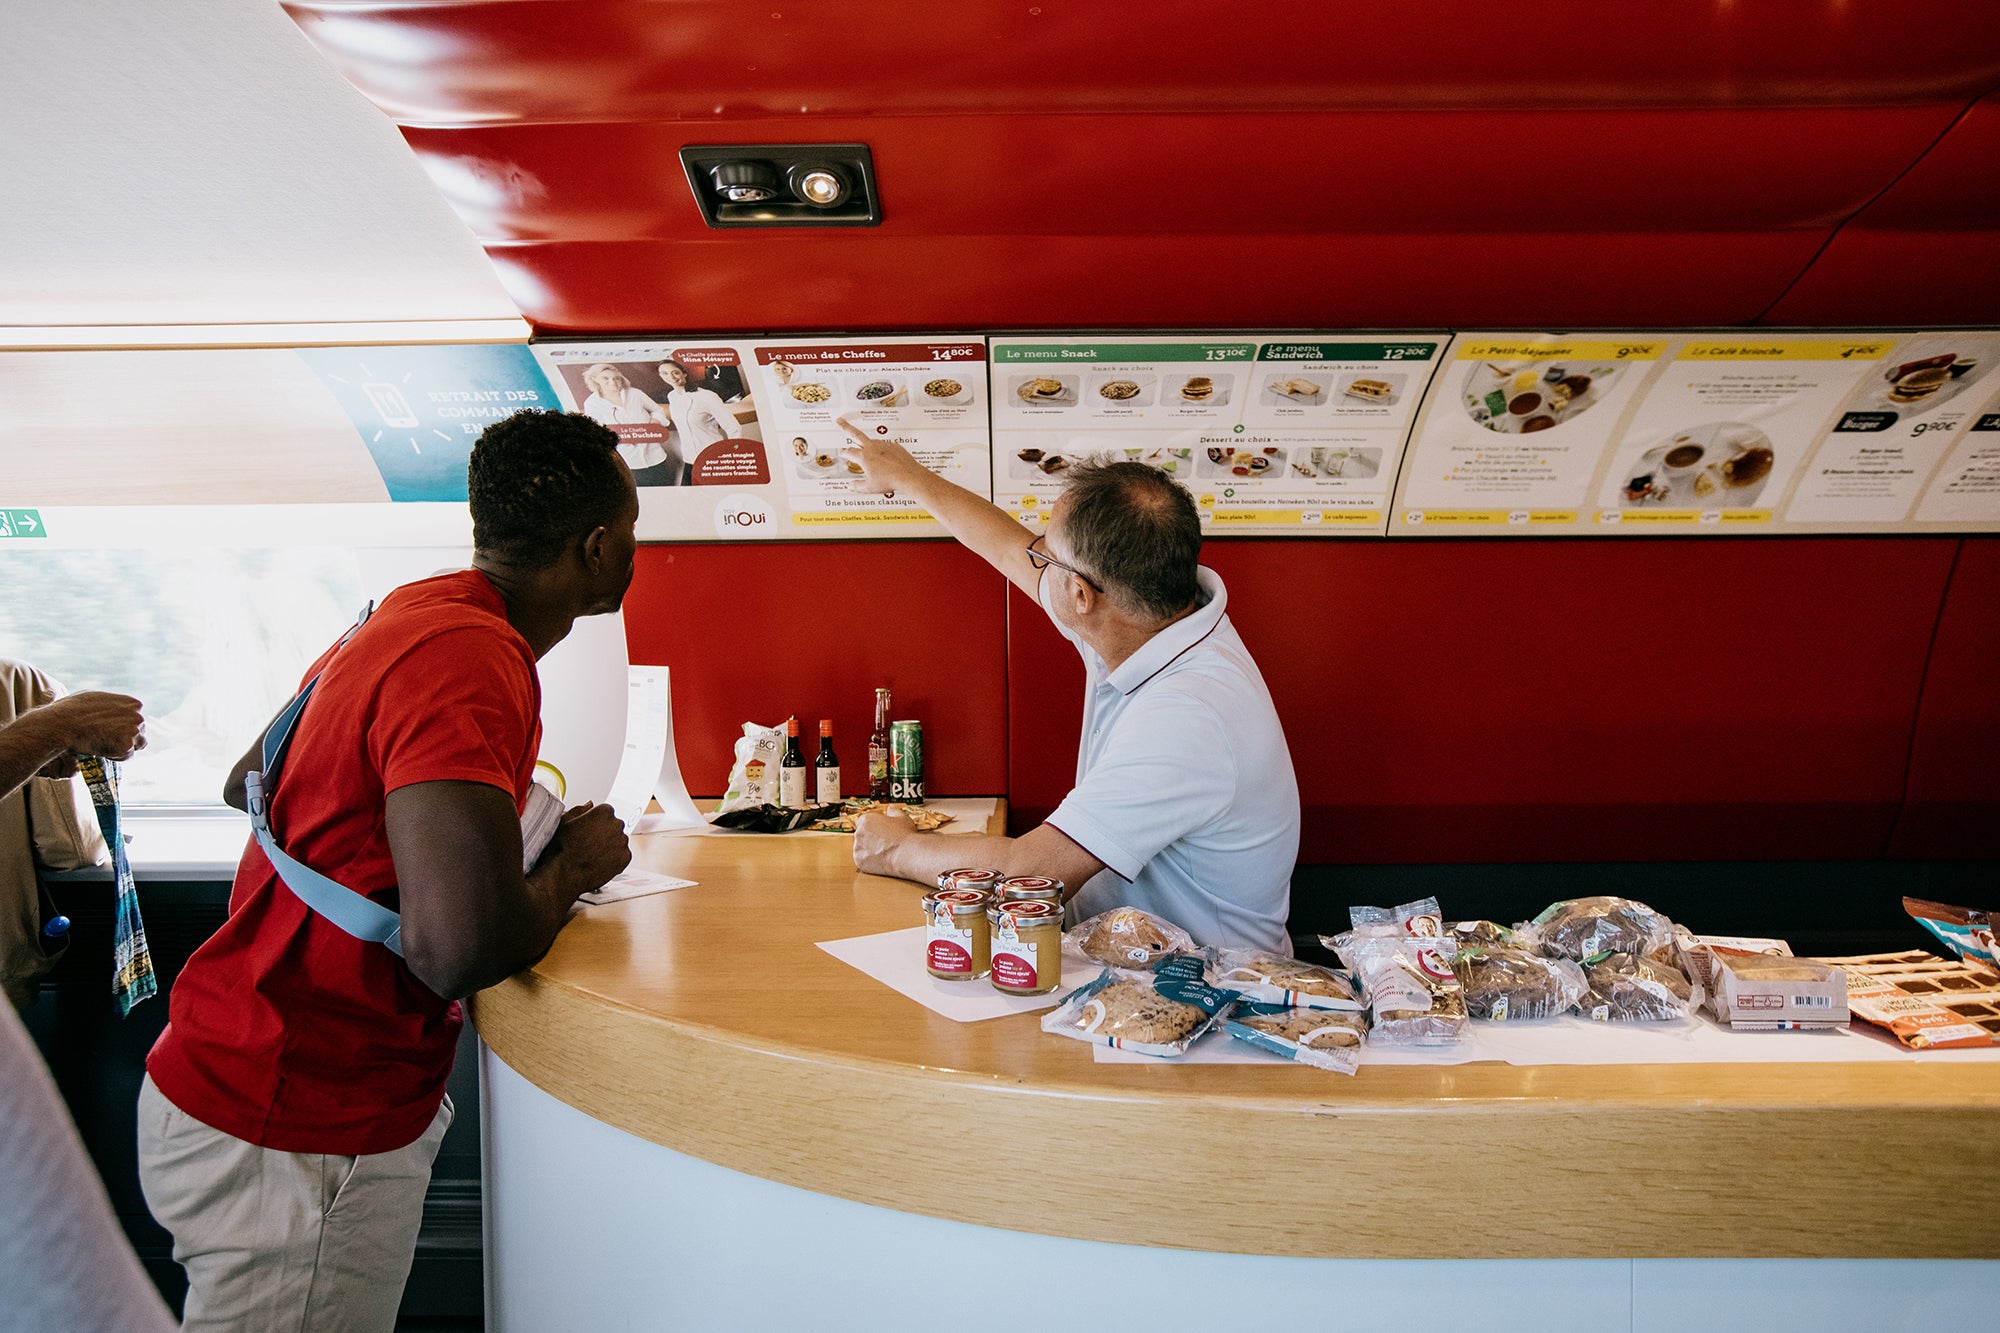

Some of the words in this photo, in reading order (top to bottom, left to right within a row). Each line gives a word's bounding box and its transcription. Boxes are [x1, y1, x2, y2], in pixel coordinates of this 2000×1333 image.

[768, 352, 782, 361] Le
[784, 352, 818, 360] menu
[820, 351, 840, 360] des
[842, 349, 886, 359] Cheffes
[1006, 349, 1020, 358] Le
[1023, 350, 1058, 358] menu
[1061, 349, 1098, 358] Snack
[1266, 350, 1324, 359] Sandwich
[428, 391, 501, 402] RETRAIT
[504, 390, 539, 401] DES
[438, 405, 545, 418] COMMAN
[1841, 420, 1882, 430] Burger
[894, 436, 919, 444] choix
[890, 778, 924, 799] eke
